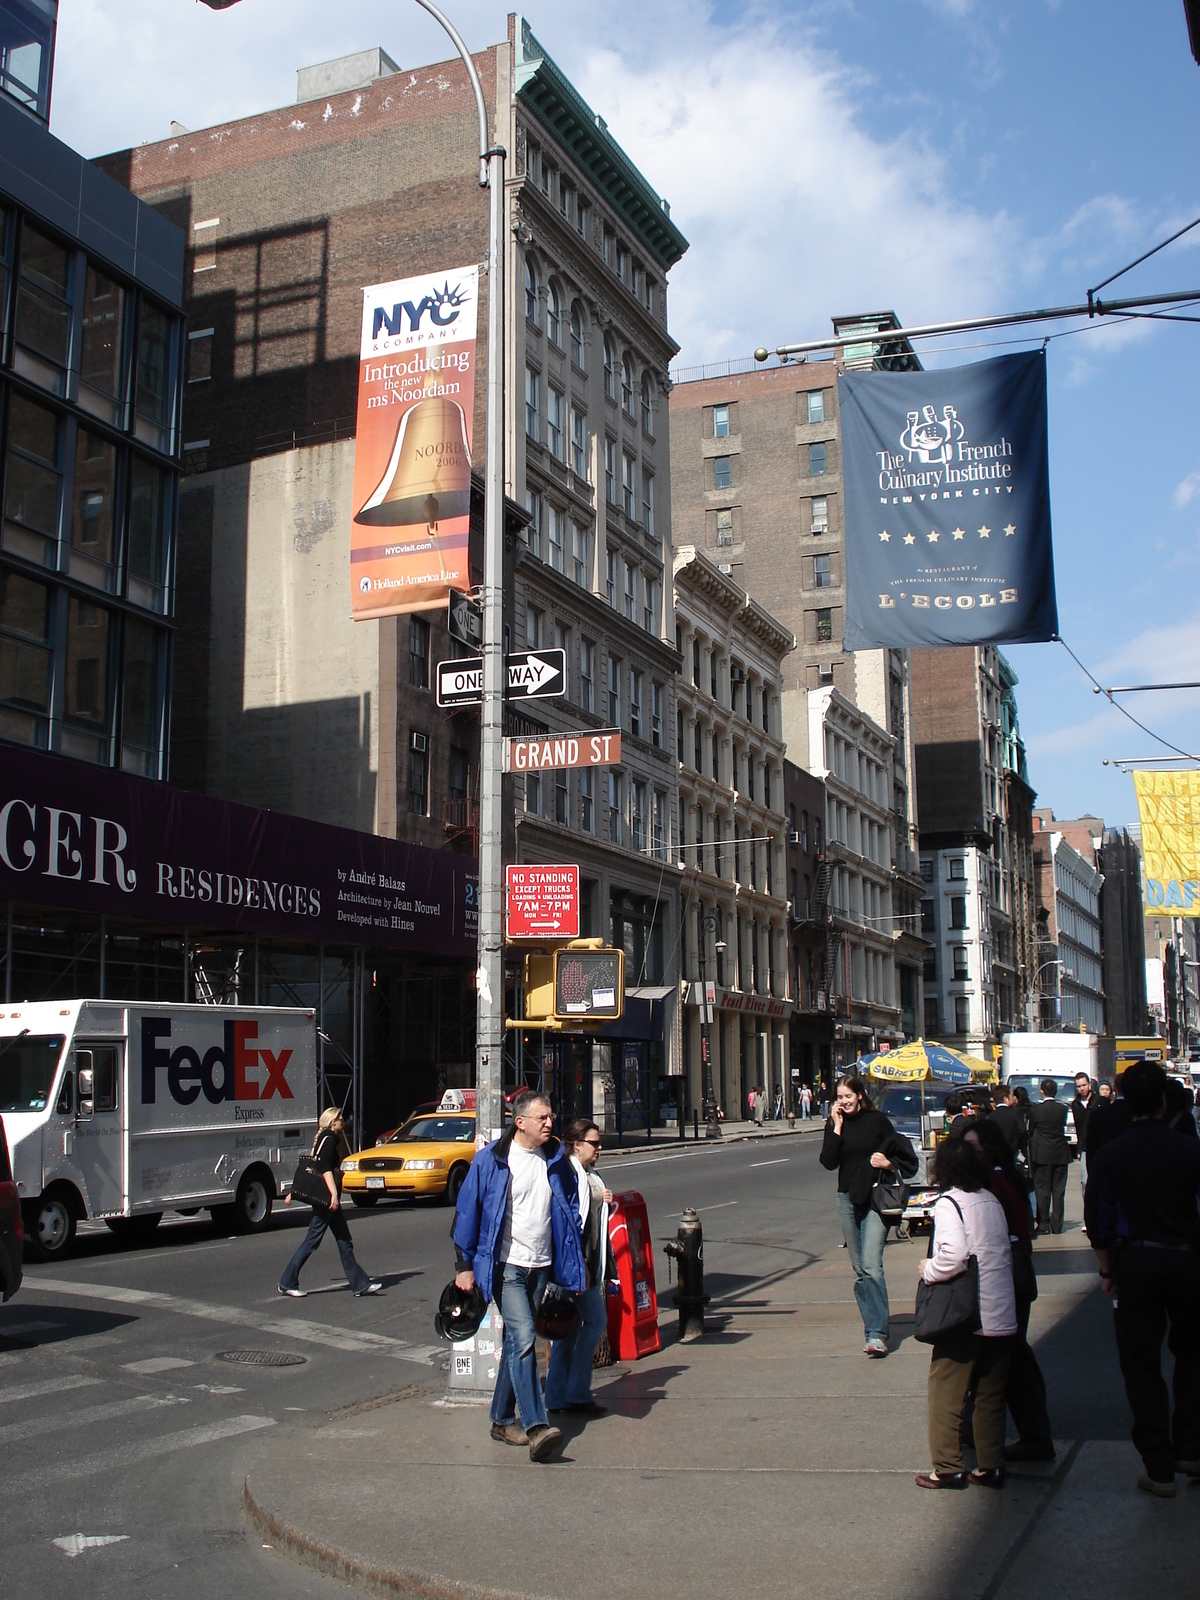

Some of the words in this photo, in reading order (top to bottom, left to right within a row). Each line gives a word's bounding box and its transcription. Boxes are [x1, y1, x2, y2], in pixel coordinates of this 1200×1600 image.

[372, 283, 466, 340] NYC
[372, 342, 379, 352] &
[383, 328, 458, 349] COMPANY
[363, 350, 471, 383] Introducing
[384, 379, 399, 391] the
[401, 375, 422, 387] new
[367, 395, 388, 409] ms
[391, 381, 461, 405] Noordam
[436, 457, 462, 467] 2006
[876, 450, 905, 471] The
[957, 437, 1013, 461] French
[879, 468, 943, 491] Culinary
[945, 461, 1012, 484] Institute
[880, 496, 913, 505] NEW
[920, 490, 963, 501] YORK
[972, 486, 1013, 496] CITY
[385, 542, 432, 556] NYCvisit.com
[373, 576, 404, 590] Holland
[405, 571, 440, 586] America
[440, 570, 460, 581] Line
[925, 565, 971, 574] RESTAURANT
[878, 587, 1019, 610] L'ECOLE
[457, 608, 475, 633] ONE
[454, 672, 483, 690] ONE
[509, 666, 544, 684] WAY
[515, 739, 579, 769] GRAND
[590, 736, 612, 763] ST
[0, 799, 137, 893] CER
[156, 862, 321, 917] RESIDENCES
[337, 869, 347, 883] by
[348, 869, 376, 886] André
[378, 874, 406, 891] Balazs
[512, 873, 525, 884] NO
[529, 872, 574, 883] STANDING
[515, 885, 541, 893] EXCEPT
[543, 885, 571, 893] TRUCKS
[1146, 879, 1200, 908] DAF
[338, 890, 382, 907] Architecture
[383, 897, 391, 911] by
[393, 897, 412, 911] Jean
[414, 900, 440, 916] Nouvel
[516, 901, 570, 912] 7AM-7PM
[337, 910, 372, 927] Developed
[374, 917, 389, 928] with
[391, 916, 415, 931] Hines
[721, 992, 744, 1009] Pearl
[745, 996, 765, 1012] River
[141, 1016, 294, 1105] FedEx
[873, 1064, 924, 1077] SABRETT
[234, 1106, 265, 1122] Express
[235, 1136, 265, 1148] fedex.com
[457, 1358, 471, 1368] BNE
